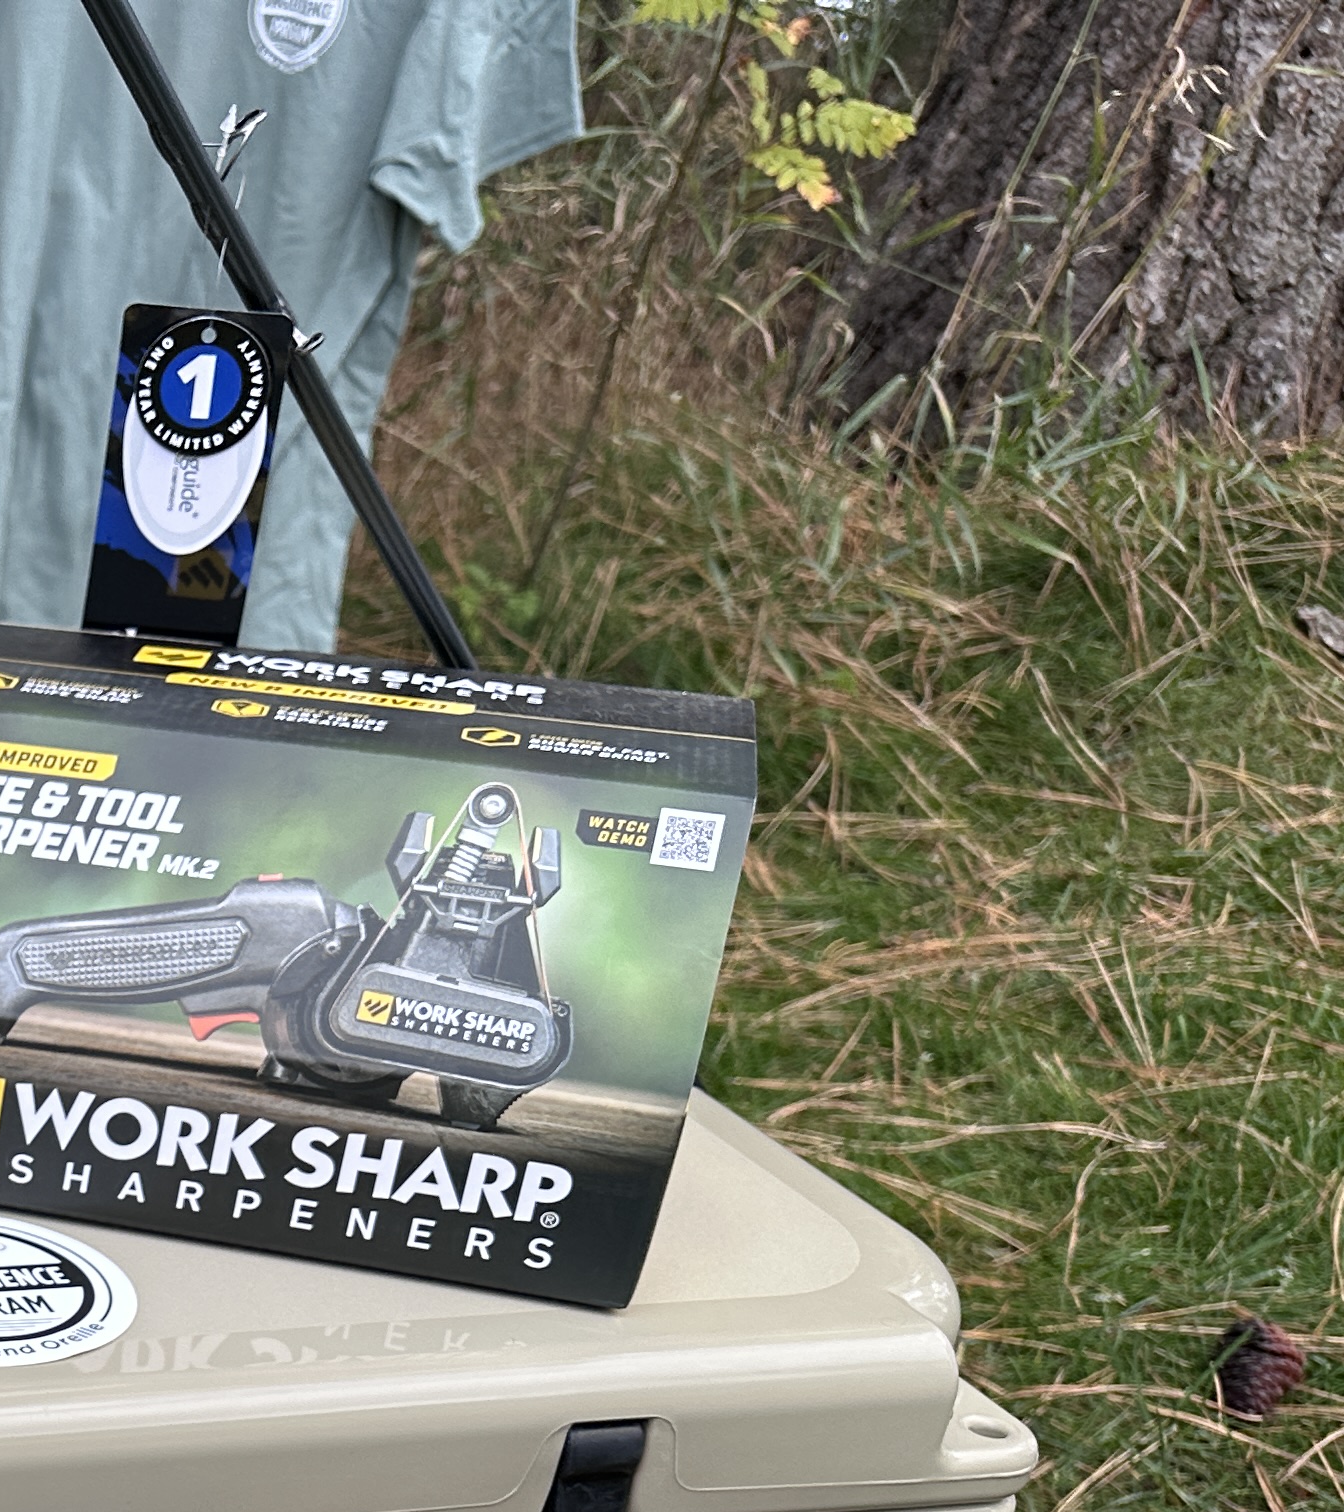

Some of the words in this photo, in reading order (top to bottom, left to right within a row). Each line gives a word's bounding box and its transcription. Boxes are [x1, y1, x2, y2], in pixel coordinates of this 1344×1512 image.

[144, 336, 175, 371] ONE
[138, 378, 156, 423] YEAR
[177, 353, 217, 419] 1
[228, 339, 264, 435] WARRANTY
[154, 423, 225, 451] LIMITED
[214, 663, 544, 704] SHARPENERS
[216, 652, 371, 677] WORK
[381, 669, 547, 698] SHARP
[188, 677, 246, 689] NEW
[292, 687, 449, 711] IMPROVED
[528, 738, 616, 752] SHARPEN
[528, 743, 594, 756] POWER
[598, 751, 658, 763] GRIND
[31, 781, 70, 818] &
[76, 784, 185, 834] TOOL
[588, 815, 650, 834] WATCH
[598, 830, 648, 847] DEMO
[157, 854, 220, 880] MK.2
[391, 1016, 530, 1052] SHARPENERS
[395, 997, 462, 1027] WORK
[463, 1011, 536, 1040] SHARP
[15, 1082, 277, 1180] WORK
[284, 1126, 574, 1222] SHARP
[8, 1153, 554, 1270] SHARPENERS
[42, 1319, 105, 1352] Oreille
